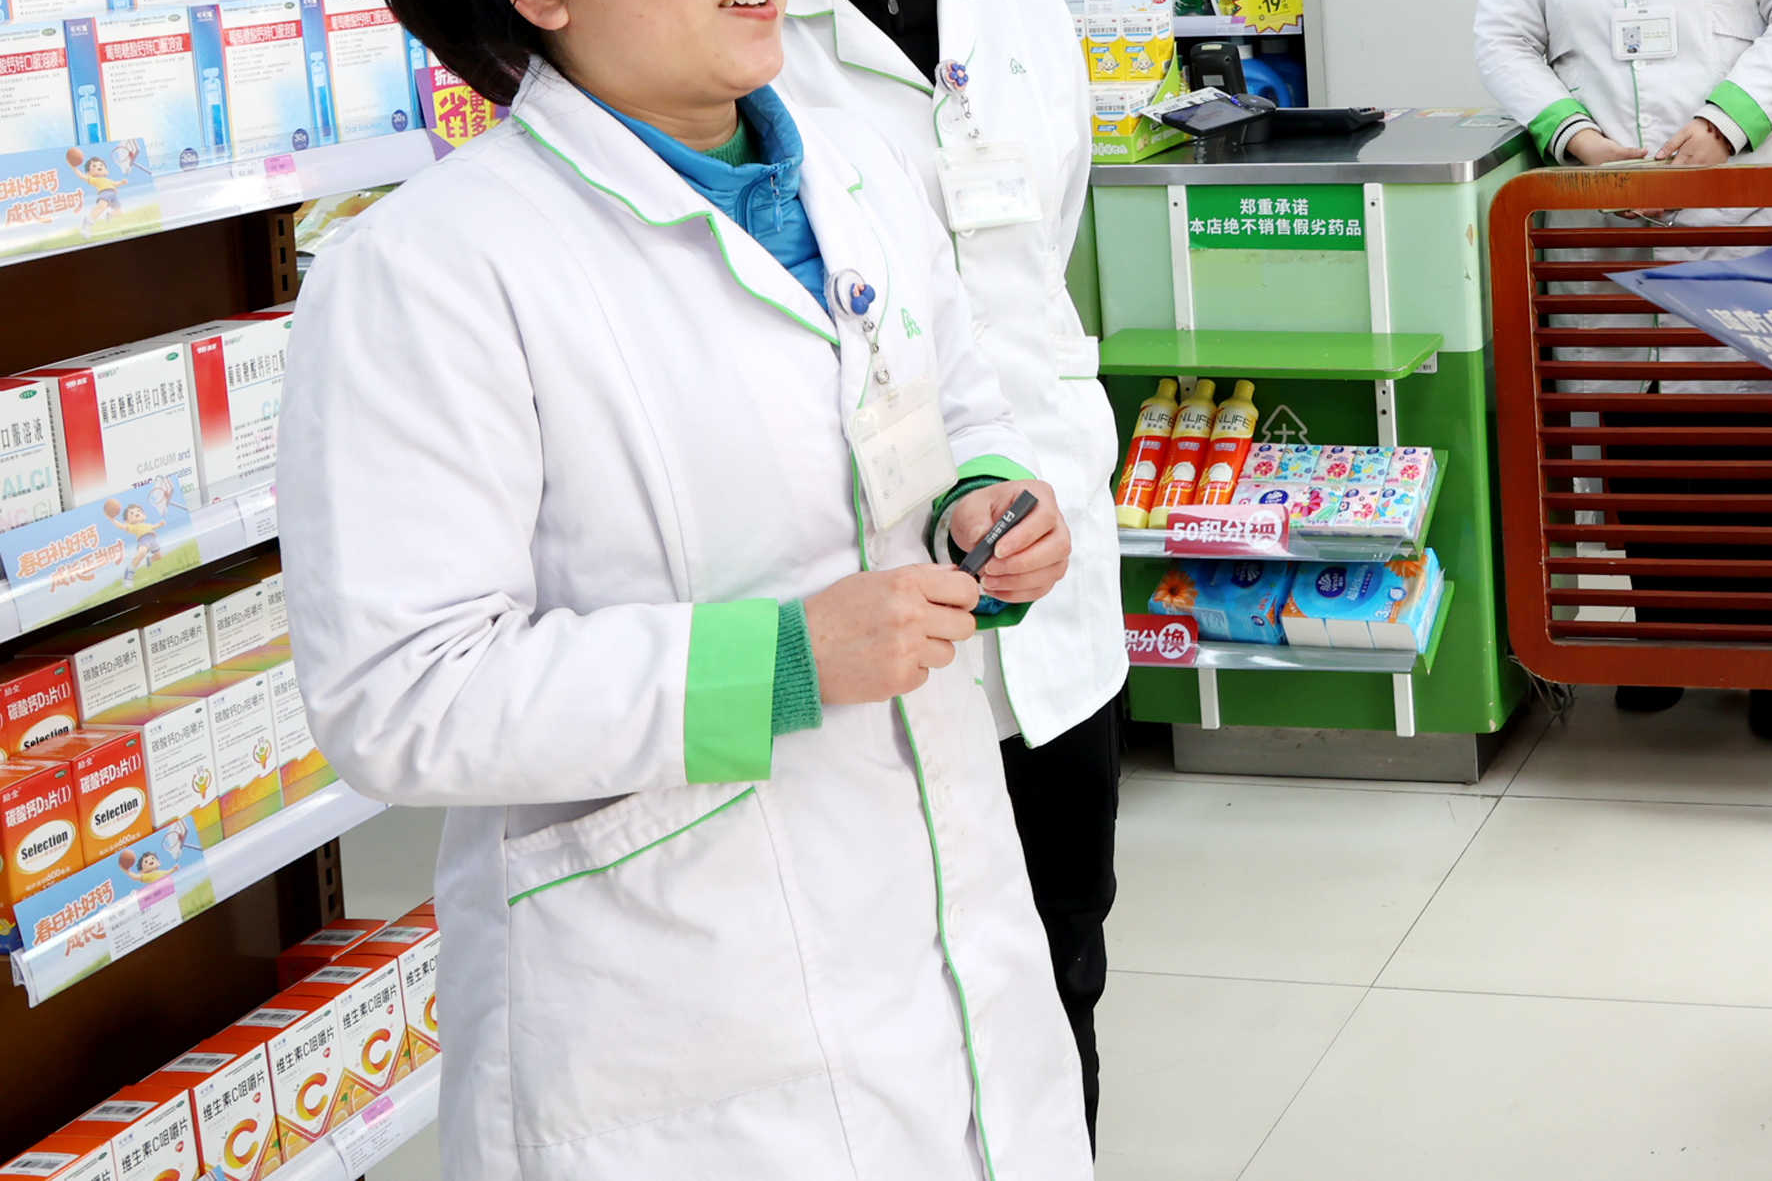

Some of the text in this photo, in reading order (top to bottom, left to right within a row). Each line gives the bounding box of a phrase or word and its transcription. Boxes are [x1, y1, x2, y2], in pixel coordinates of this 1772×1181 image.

[434, 68, 468, 87] 折后
[7, 190, 83, 227] 成长正当时
[1239, 198, 1310, 217] 郑重承诺
[1189, 217, 1363, 237] 本店绝不销售假劣药品
[16, 523, 100, 578] 春日补好钙
[94, 796, 139, 826] Selection
[20, 829, 69, 861] Selection
[34, 879, 115, 946] 春日补好钙
